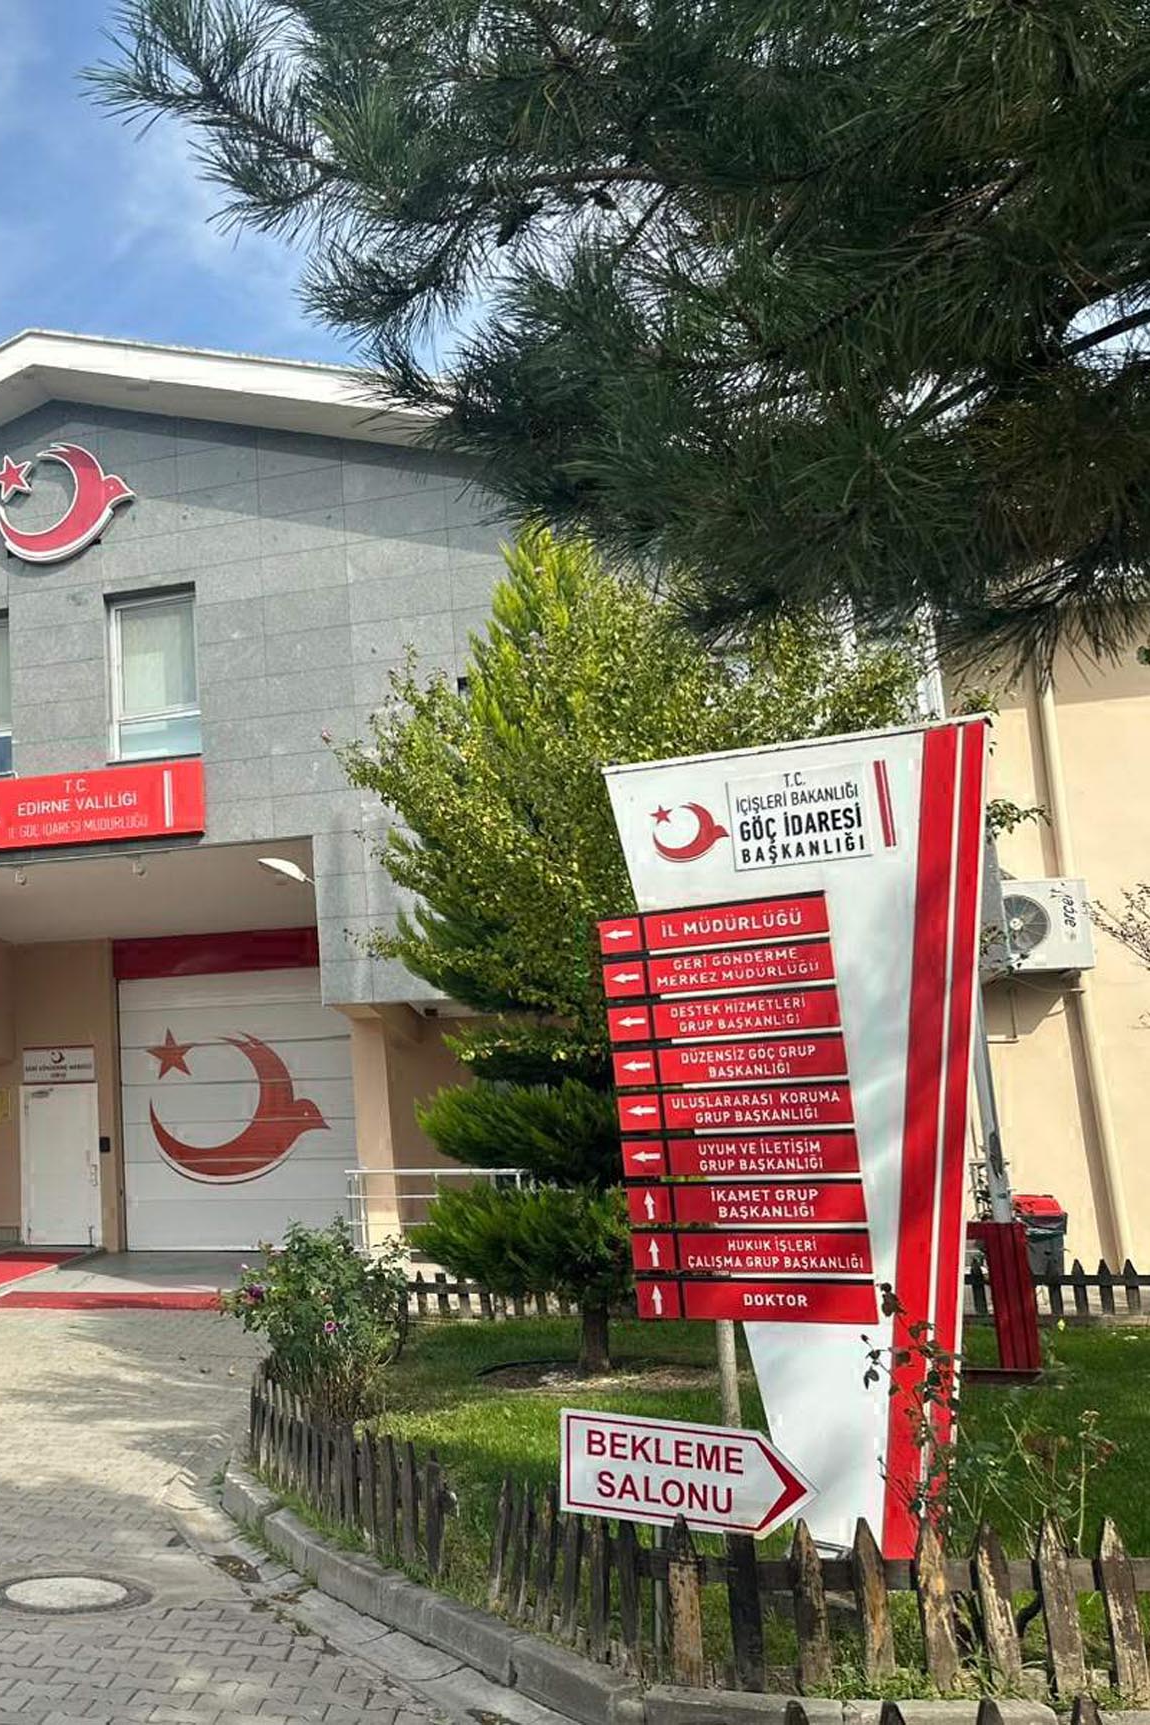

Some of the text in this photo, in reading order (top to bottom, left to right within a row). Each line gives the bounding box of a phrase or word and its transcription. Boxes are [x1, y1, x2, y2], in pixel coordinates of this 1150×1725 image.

[783, 772, 806, 788] T.C.
[736, 780, 859, 816] İÇİŞLERİ BAKANLIĞI
[739, 802, 862, 845] GÖÇ İDARESİ
[741, 831, 865, 864] BAŞKANLIĞI
[661, 908, 802, 938] İL MÜDÜRLÜĞÜ
[673, 948, 798, 971] GERİ GÖNDERME
[656, 957, 819, 987] MERKEZ MÜDÜRLÜĞÜ
[670, 993, 806, 1018] DESTEK HİZMETLERİ
[679, 1019, 713, 1032] GRUP
[680, 1044, 816, 1064] DÜZENSİZ GÖÇ GRUP
[708, 1059, 790, 1078] BAŞKANLIĞI
[671, 1090, 841, 1109] ULUSLARARASI KORUMA
[695, 1104, 819, 1124] GRUP BAŞKANLIĞI
[698, 1138, 821, 1155] UYUM VE İLETİŞİM
[699, 1154, 824, 1172] GRUP BAŞKANLIĞI
[710, 1186, 819, 1202] İKAMET GRUP
[718, 1202, 815, 1220] BAŞKANLIĞI
[727, 1236, 817, 1253] HUKUK İŞLERİ
[687, 1253, 864, 1269] ÇALIŞMA GRUP BAŞKANLIĞI
[743, 1293, 808, 1307] DOKTOR
[586, 1429, 744, 1475] BEKLEME
[596, 1471, 733, 1514] SALONU
